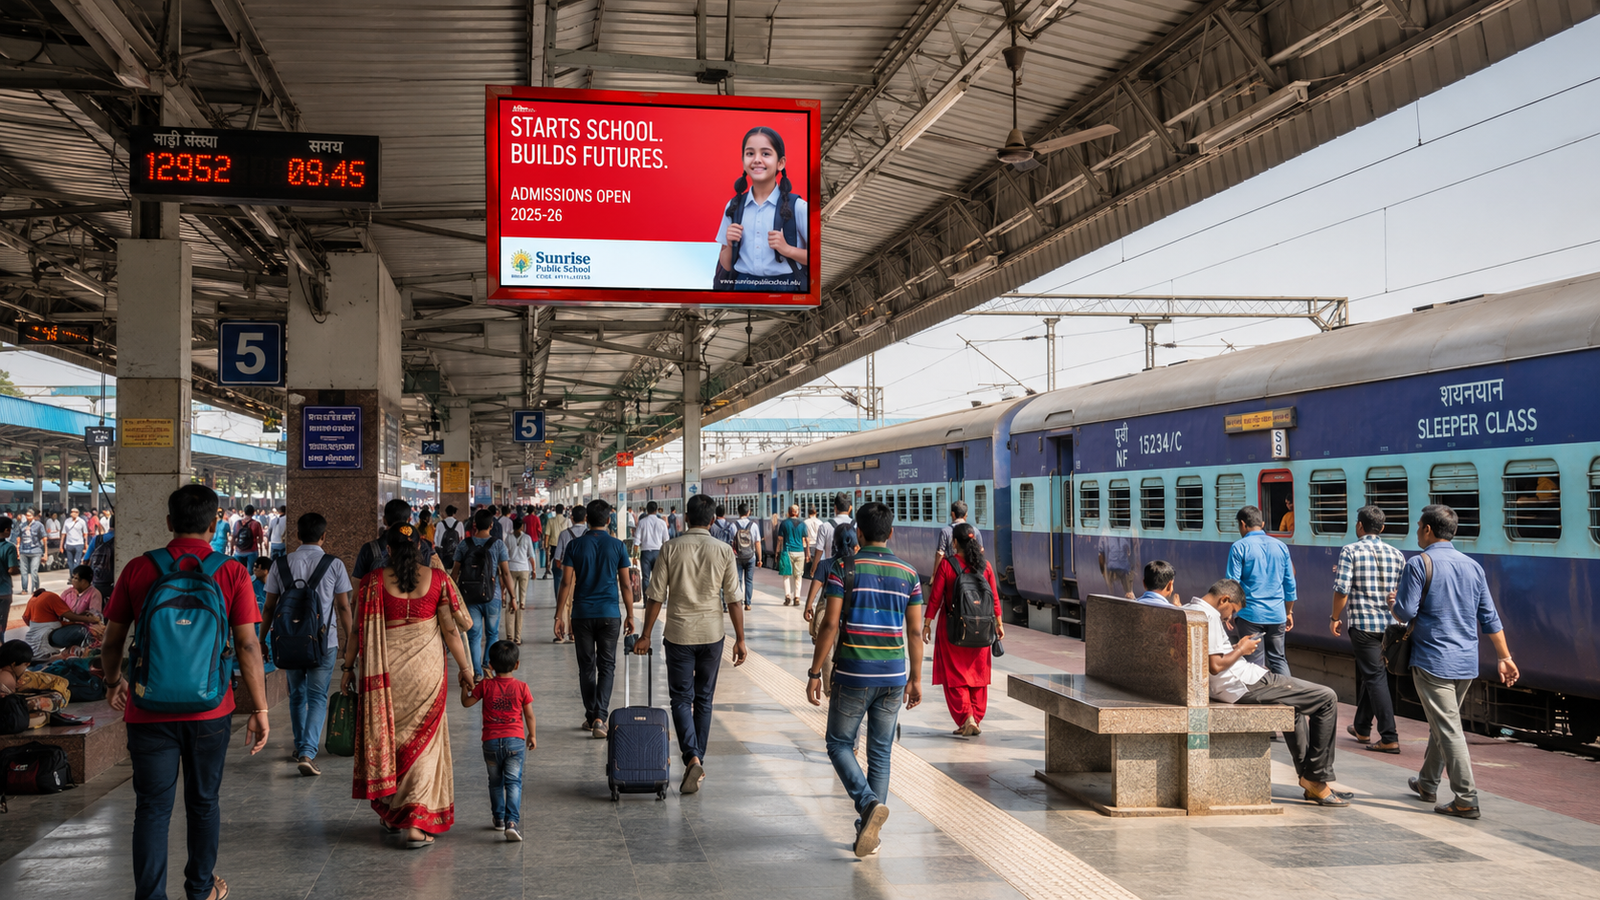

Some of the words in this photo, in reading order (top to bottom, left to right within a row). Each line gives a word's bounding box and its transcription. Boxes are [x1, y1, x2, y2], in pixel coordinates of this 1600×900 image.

[511, 116, 581, 139] STARTS
[586, 118, 663, 142] SCHOOL.
[308, 139, 344, 154] समय
[511, 143, 577, 166] BUILDS
[583, 145, 668, 169] FUTURES.
[146, 152, 232, 183] 12952
[510, 186, 593, 202] ADMISSIONS
[596, 189, 631, 204] OPEN
[510, 207, 563, 222] 2025-26
[536, 251, 591, 265] Sunrise
[536, 264, 561, 273] Public
[563, 265, 591, 273] School
[235, 332, 267, 375] 5
[1439, 378, 1504, 407] शयनयान
[520, 415, 538, 438] 5
[1418, 413, 1480, 440] SLEEPER
[1485, 407, 1538, 435] CLASS
[1139, 430, 1182, 455] 15234/C
[1116, 449, 1128, 468] NF
